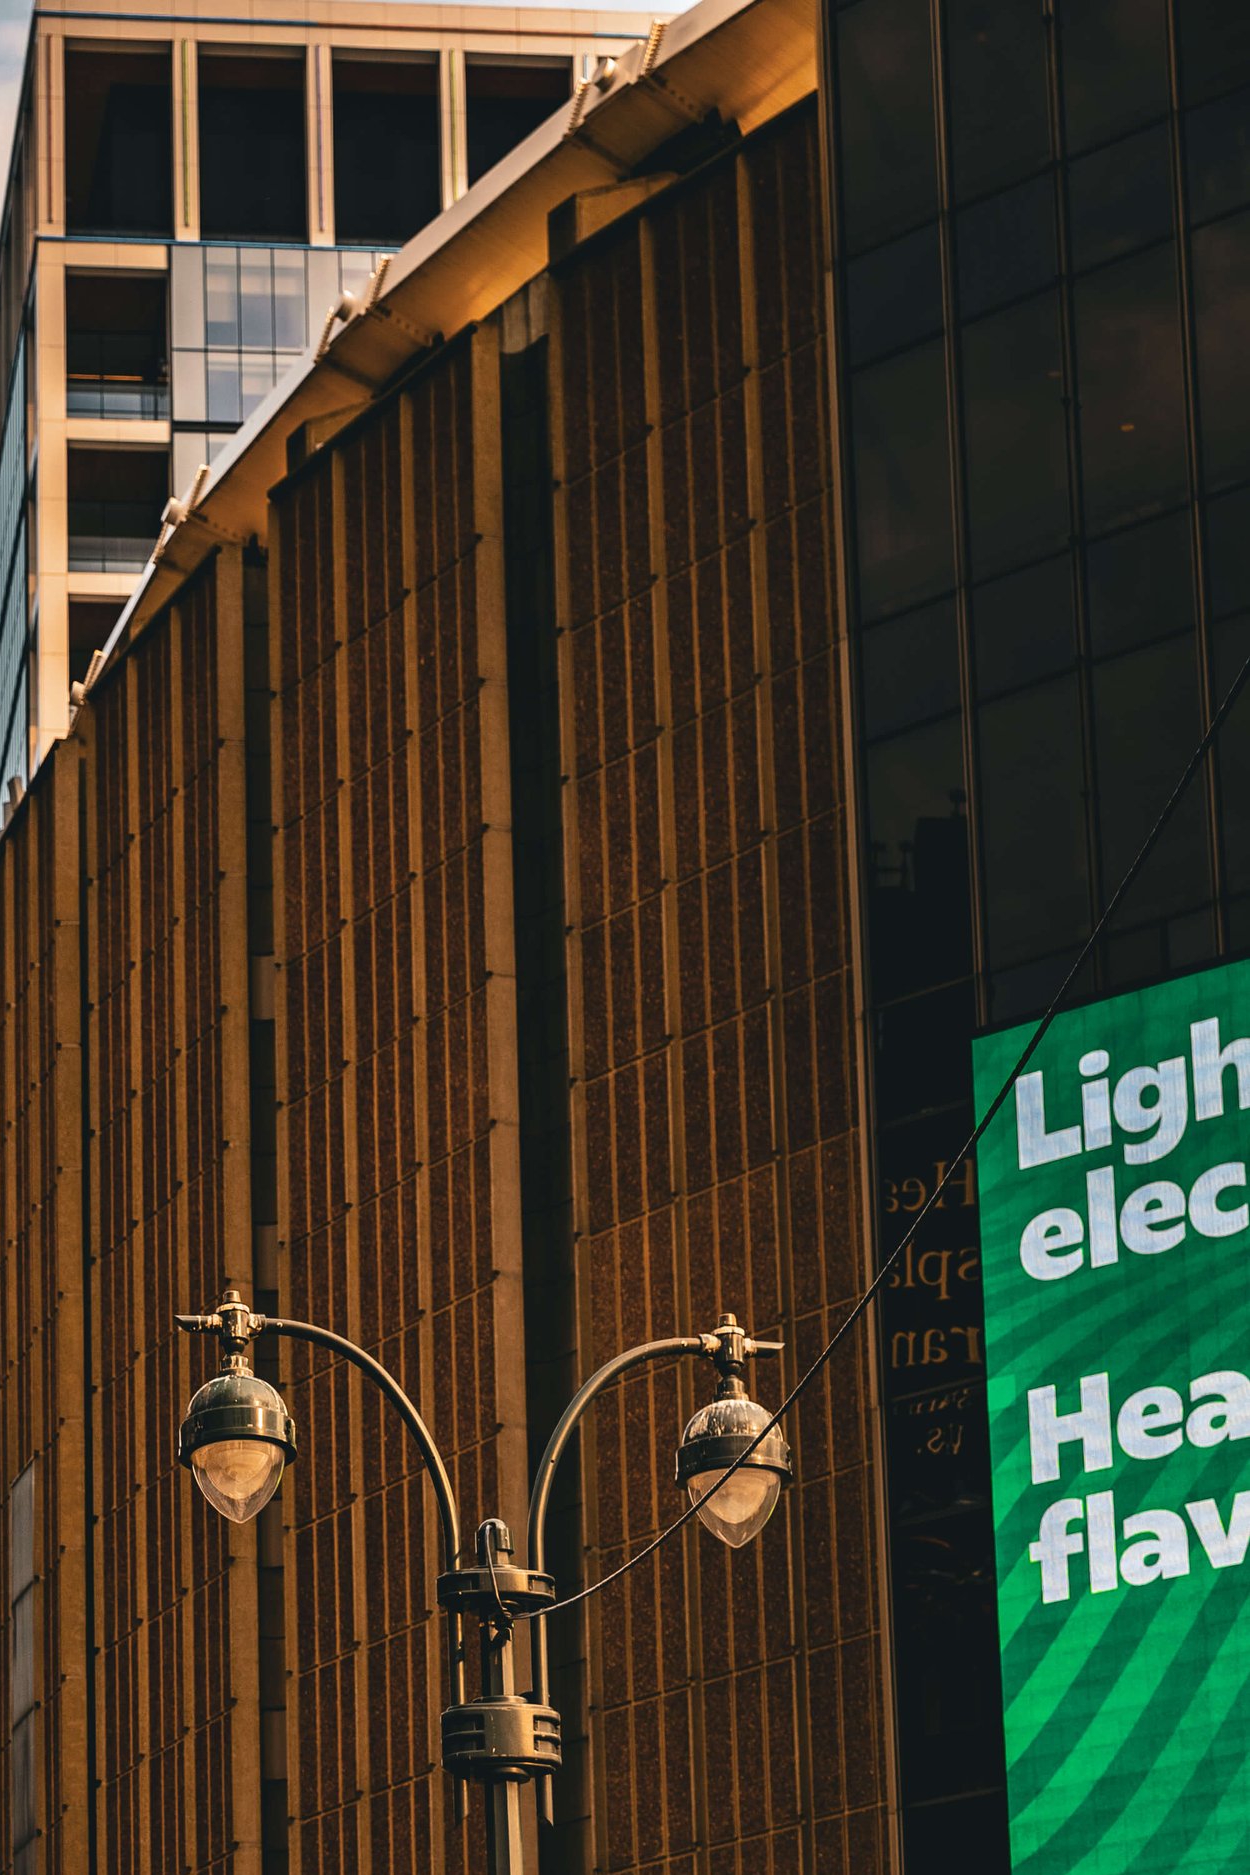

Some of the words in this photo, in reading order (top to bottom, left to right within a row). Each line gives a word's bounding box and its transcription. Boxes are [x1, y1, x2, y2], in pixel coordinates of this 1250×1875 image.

[1015, 1017, 1250, 1170] Ligh
[1020, 1162, 1249, 1281] elec
[1028, 1370, 1250, 1485] Hea
[1028, 1490, 1250, 1604] flav
